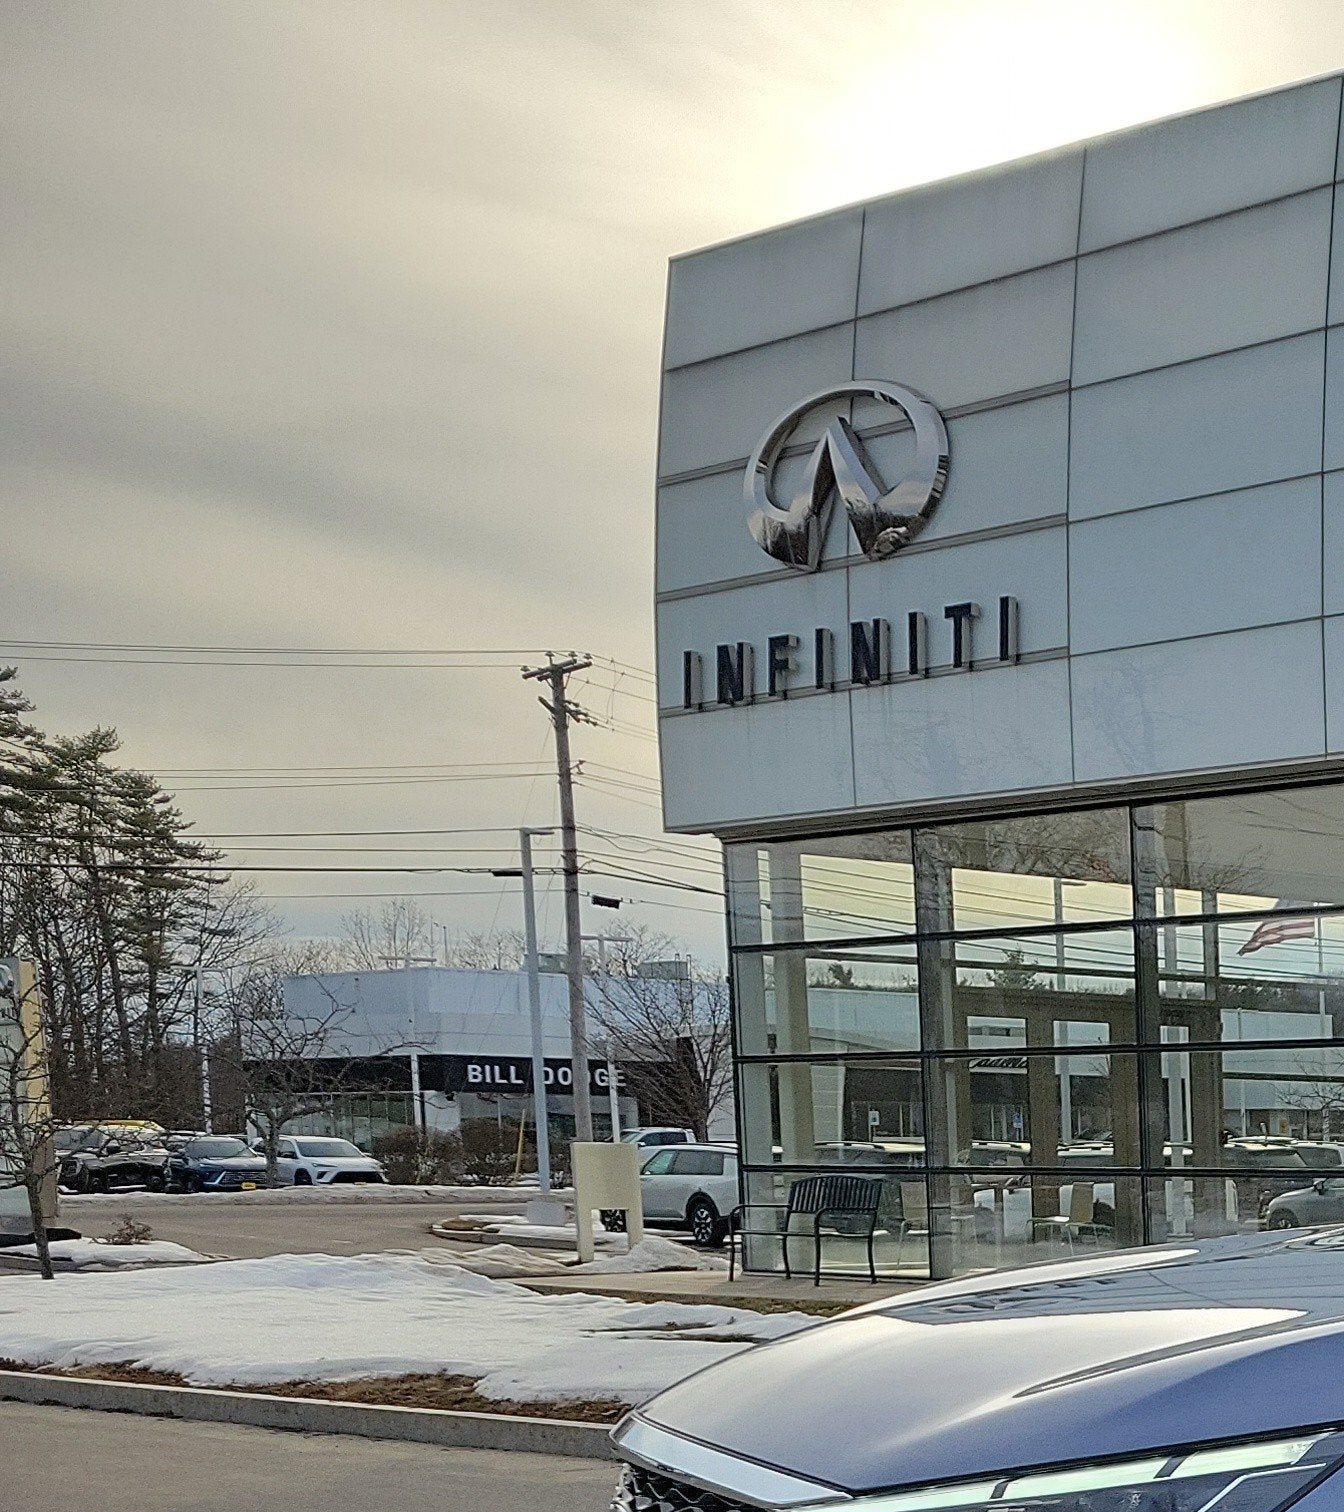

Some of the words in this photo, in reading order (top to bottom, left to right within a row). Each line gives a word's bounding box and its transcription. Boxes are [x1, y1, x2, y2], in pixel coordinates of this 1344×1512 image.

[684, 596, 1018, 711] INFINITI
[467, 1064, 525, 1084] BILL
[542, 1067, 627, 1087] DOGE
